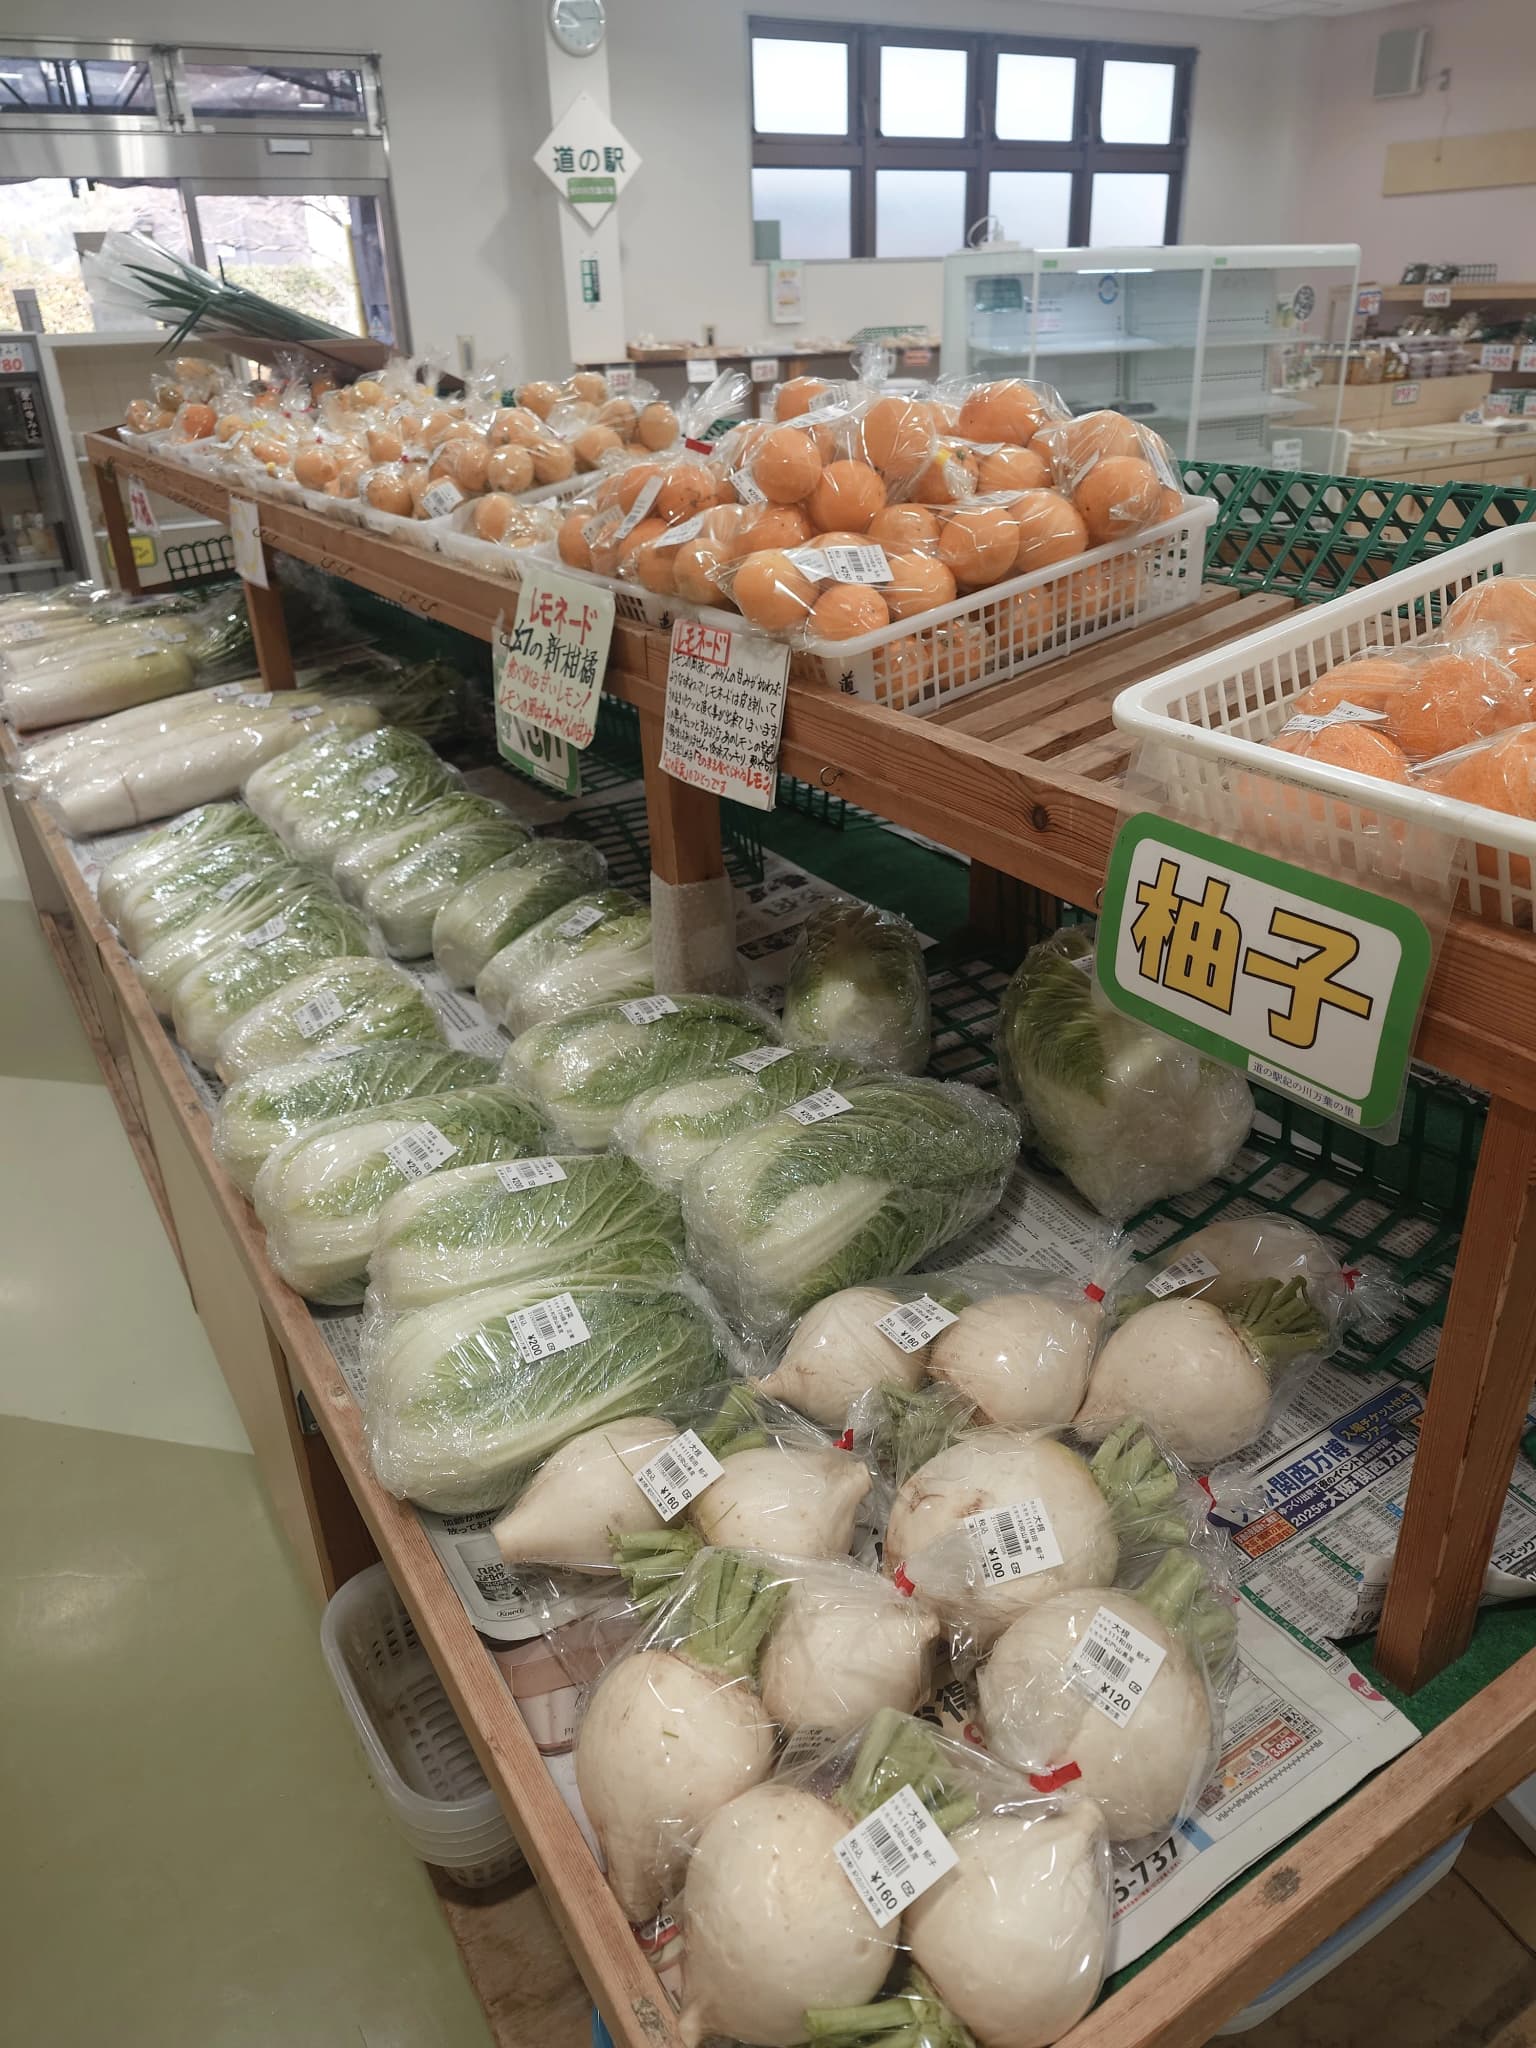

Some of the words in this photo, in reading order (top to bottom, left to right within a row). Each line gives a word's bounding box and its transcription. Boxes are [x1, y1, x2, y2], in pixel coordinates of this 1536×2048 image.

[553, 146, 625, 173] 道の駅
[529, 587, 598, 645] レモネード
[512, 619, 598, 689] 幻の新柑橘
[1130, 857, 1375, 1050] 柚子
[404, 1159, 423, 1177] ¥230
[511, 1176, 524, 1189] ¥200
[526, 1333, 542, 1356] ¥200
[898, 1330, 920, 1347] ¥160
[688, 1443, 702, 1457] 大根
[659, 1486, 680, 1510] ¥160
[1033, 1515, 1044, 1531] 大根
[978, 1518, 988, 1533] 税込
[986, 1547, 1004, 1578] ¥100
[1111, 1622, 1129, 1638] 大根
[1100, 1680, 1130, 1712] ¥120
[908, 1808, 926, 1831] 大根
[849, 1838, 863, 1858] 税込
[869, 1871, 897, 1910] ¥160
